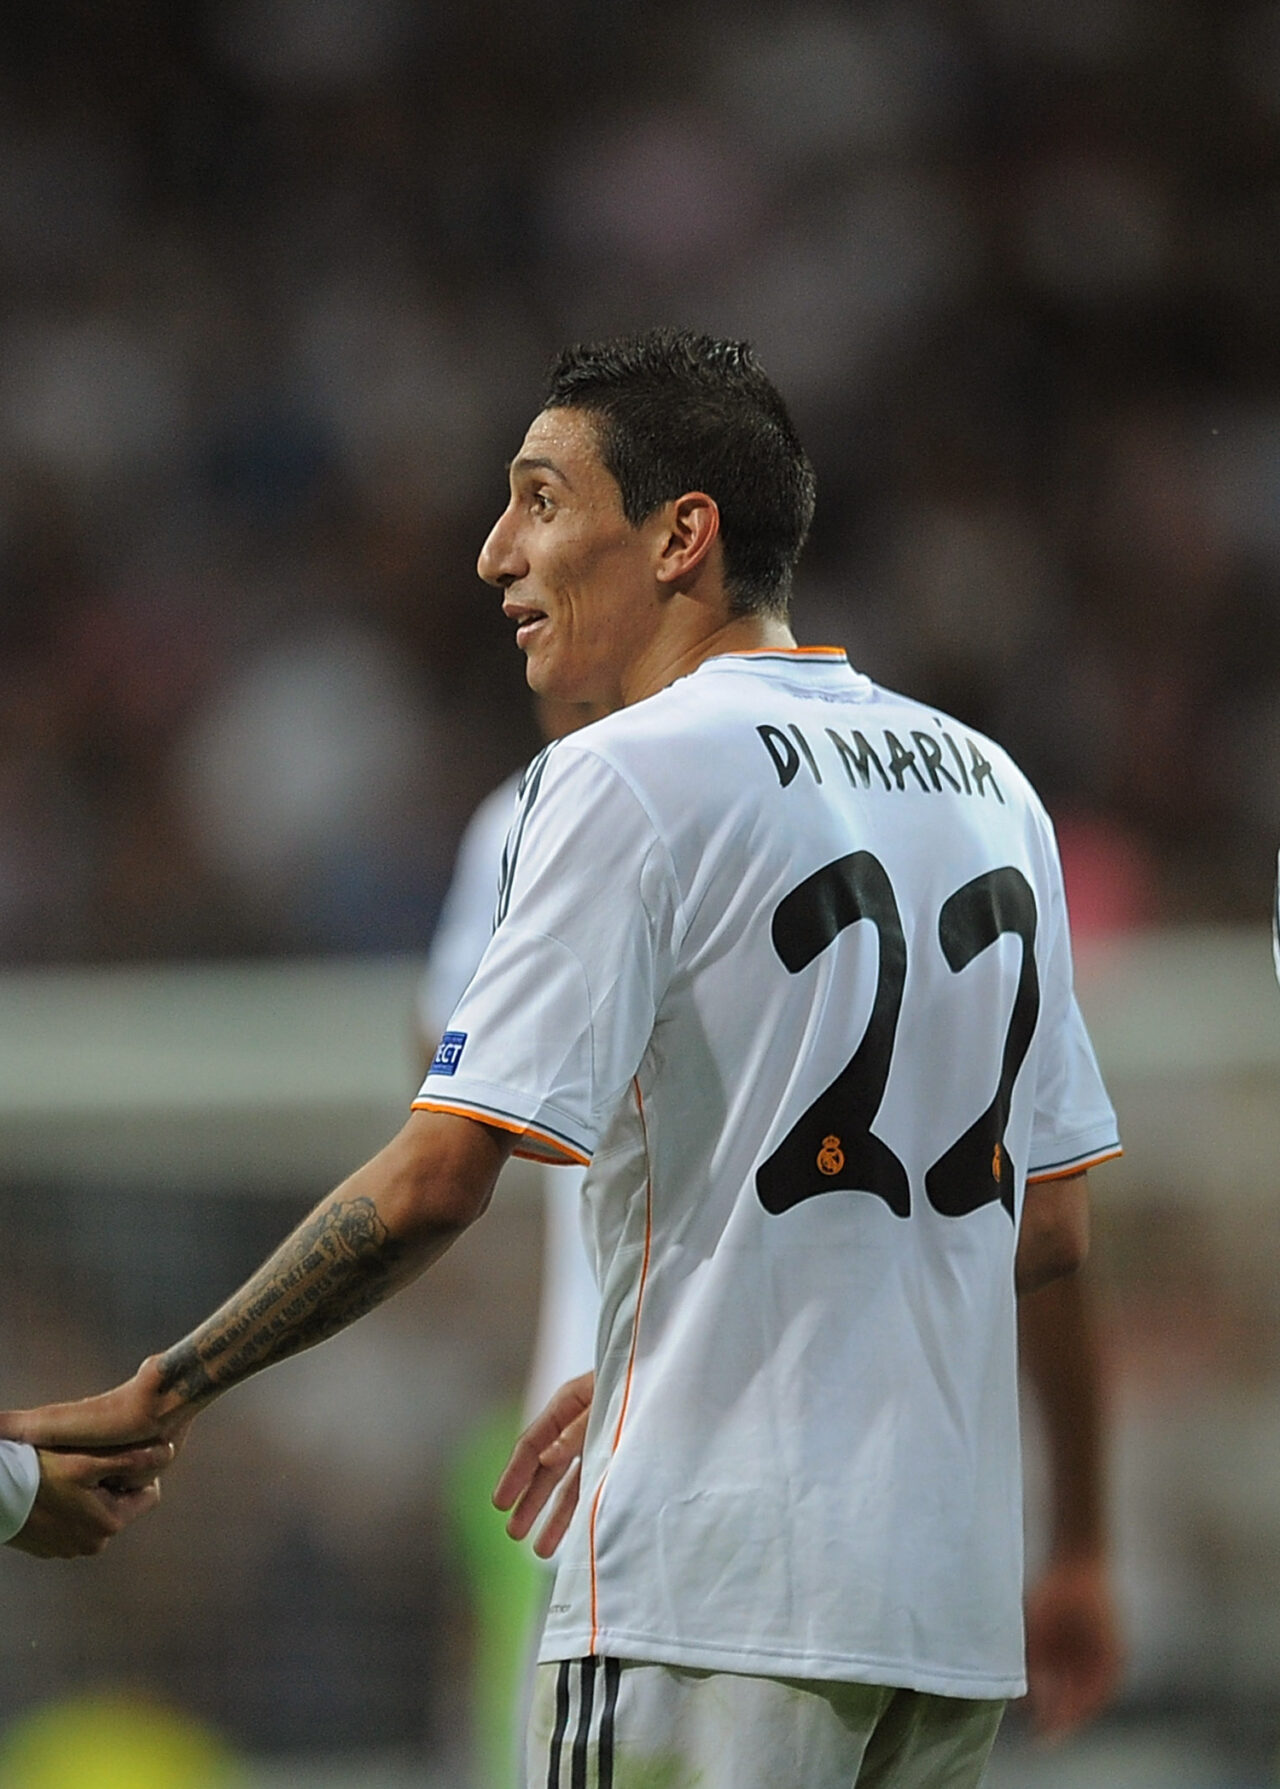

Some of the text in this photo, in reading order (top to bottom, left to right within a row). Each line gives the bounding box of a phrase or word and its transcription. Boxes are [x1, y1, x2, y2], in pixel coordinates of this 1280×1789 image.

[756, 717, 1005, 804] DI MARÍA
[756, 850, 1040, 1228] 22
